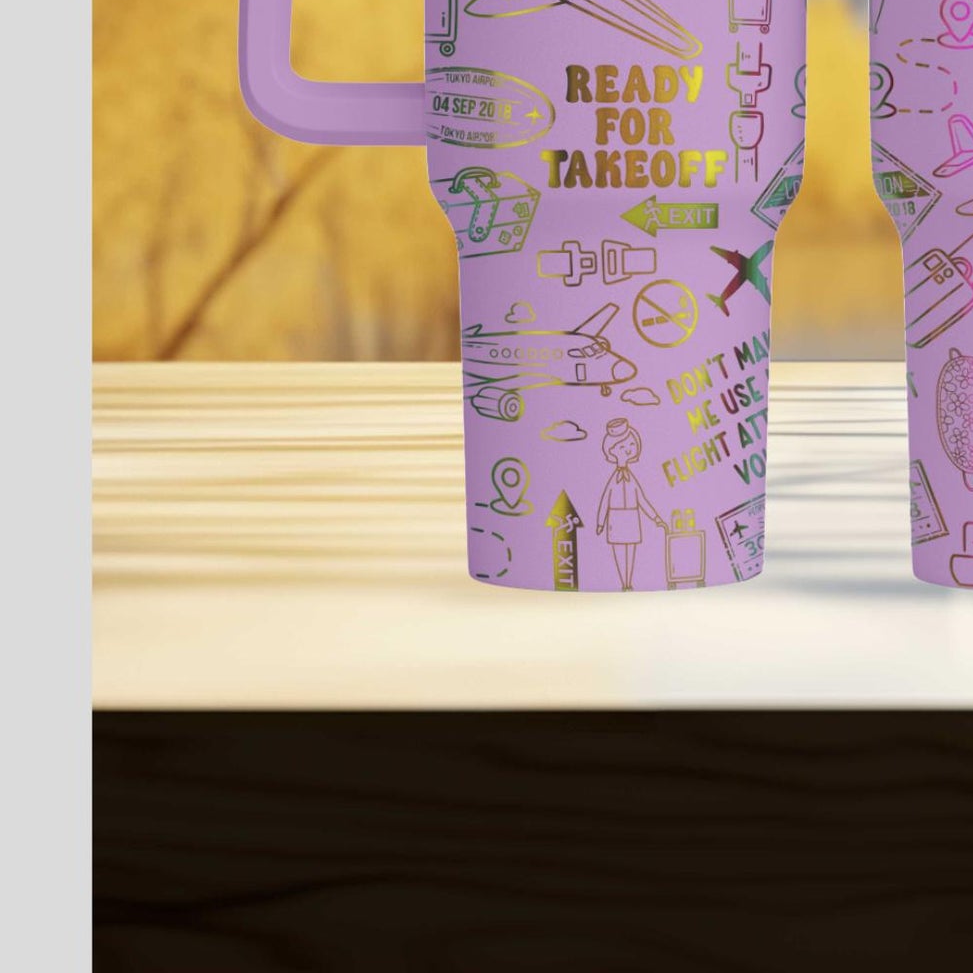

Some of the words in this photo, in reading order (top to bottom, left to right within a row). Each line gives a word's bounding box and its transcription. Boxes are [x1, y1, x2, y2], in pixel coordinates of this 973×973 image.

[445, 73, 471, 84] TOKYO
[566, 64, 703, 103] READY
[433, 96, 450, 112] 04
[452, 98, 476, 115] SEP
[440, 125, 465, 140] TOKYO
[595, 107, 675, 146] FOR
[540, 149, 728, 188] TAKEOFF
[669, 207, 715, 224] EXIT
[666, 353, 729, 405] DON'T
[686, 399, 720, 436] ME
[720, 376, 764, 414] USE
[662, 431, 730, 488] FLIGHT
[557, 540, 574, 588] EXIT
